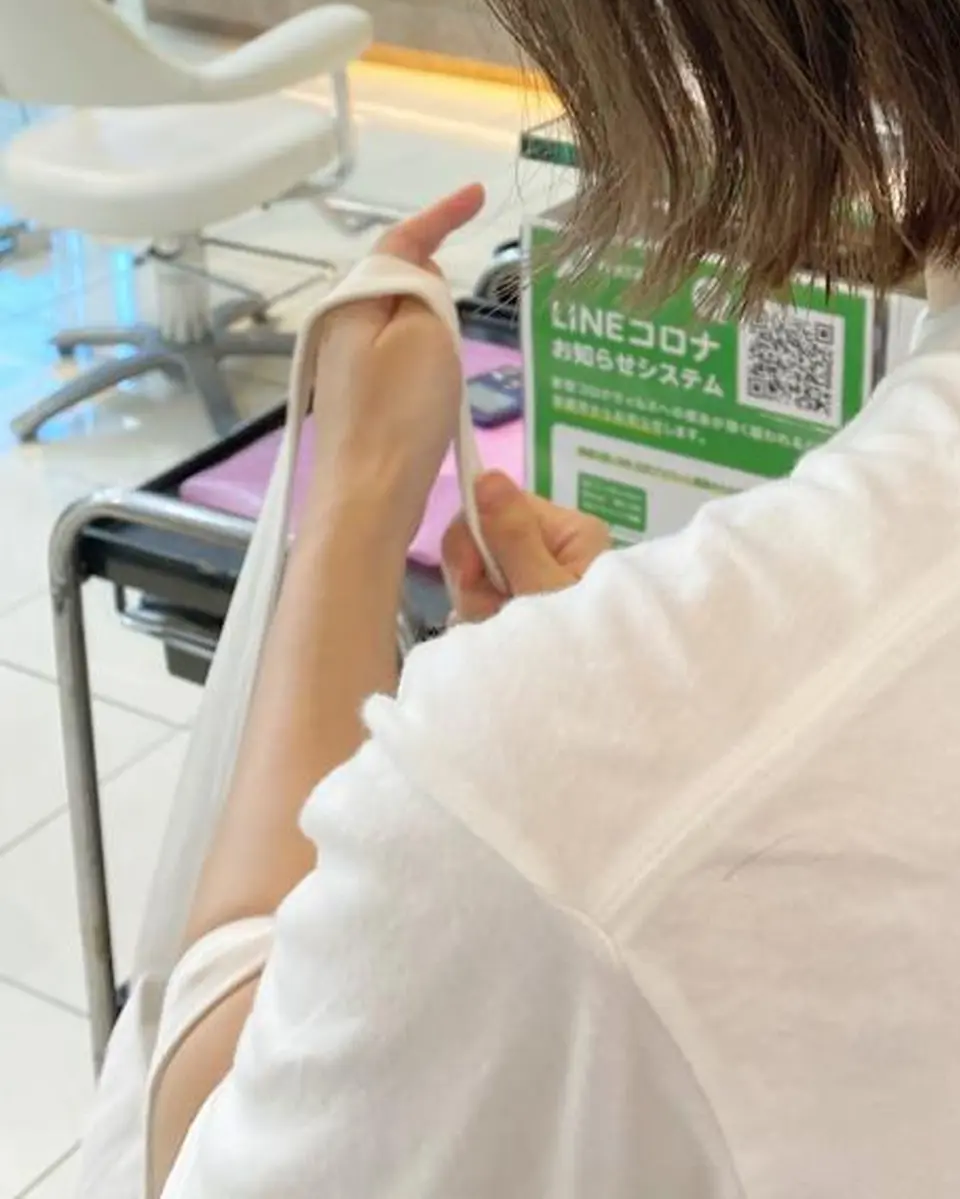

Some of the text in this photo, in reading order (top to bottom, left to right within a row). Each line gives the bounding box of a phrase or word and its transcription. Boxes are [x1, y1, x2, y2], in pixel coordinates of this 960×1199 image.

[551, 301, 721, 363] LINEコロナ
[551, 337, 725, 398] お知らせシステム
